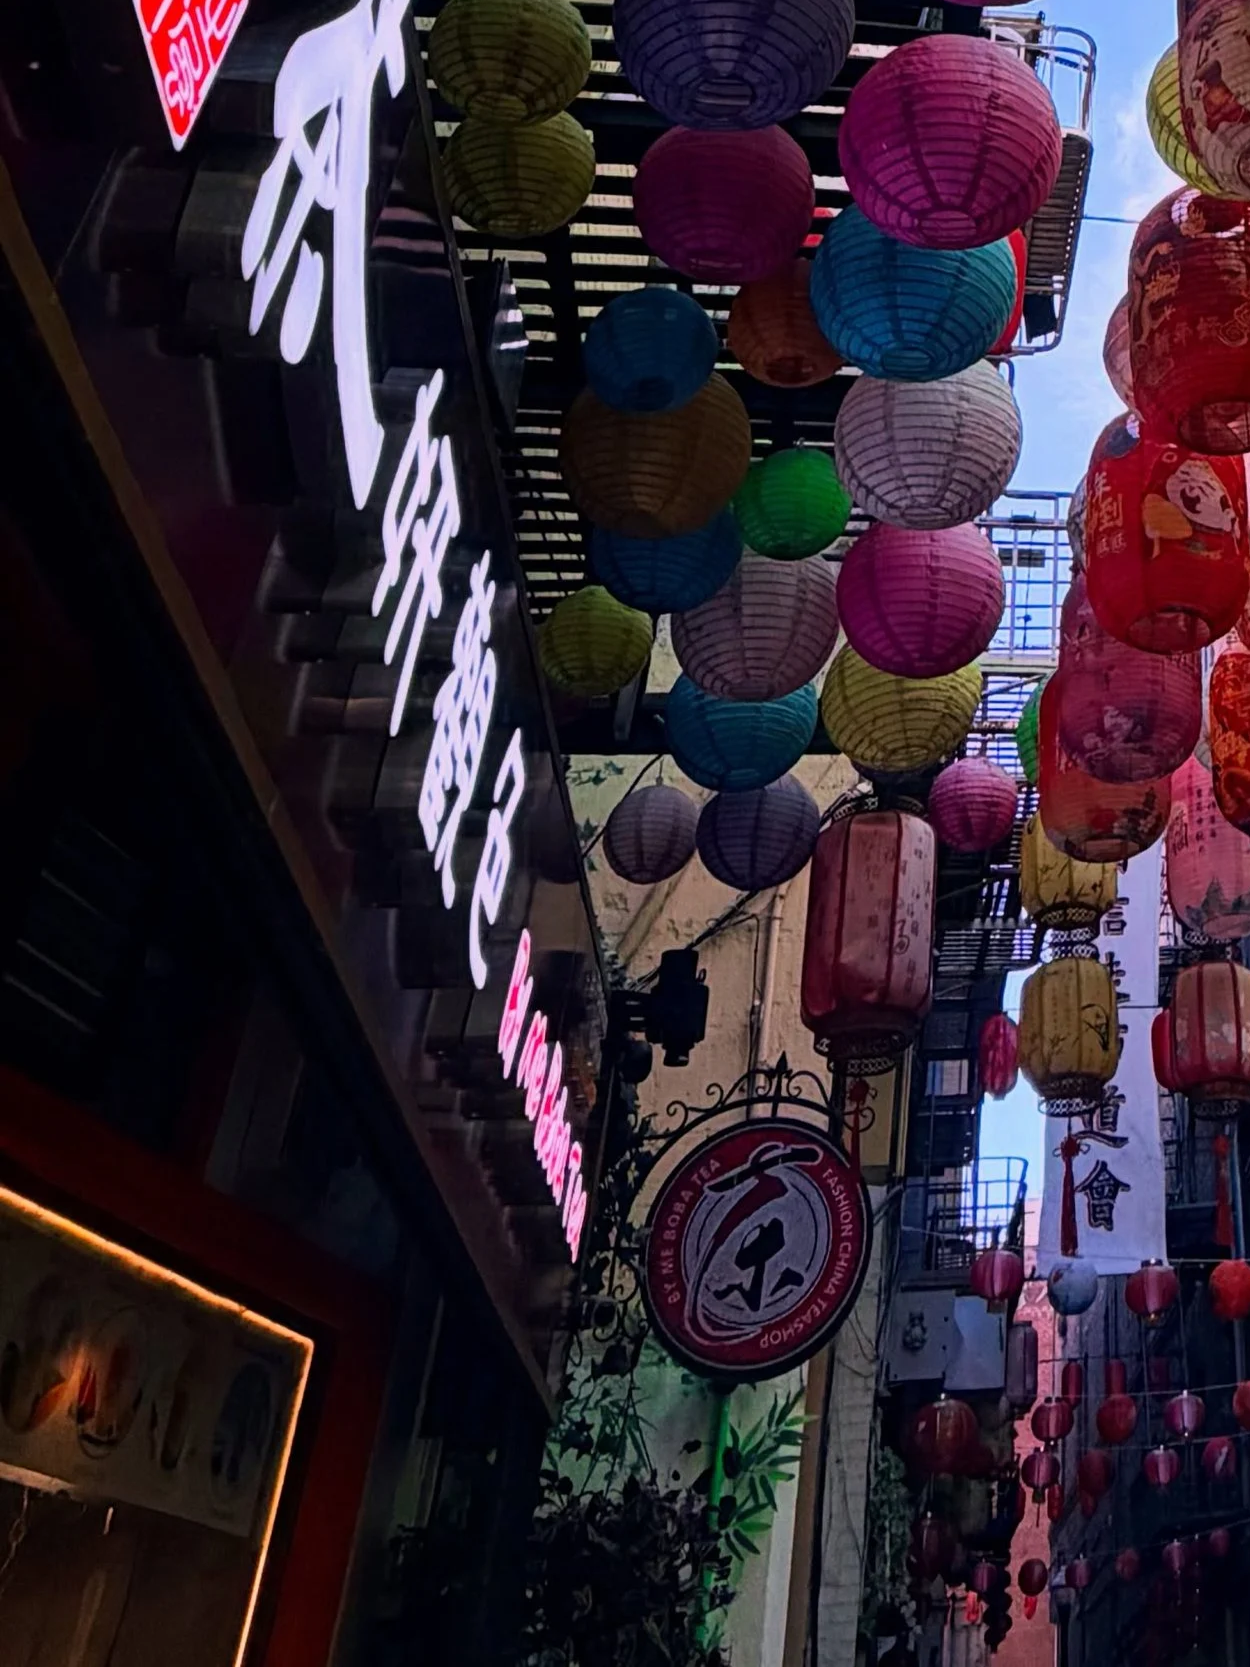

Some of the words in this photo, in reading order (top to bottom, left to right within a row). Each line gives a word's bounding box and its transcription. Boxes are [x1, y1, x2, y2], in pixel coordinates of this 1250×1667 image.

[691, 1157, 722, 1189] TEA
[663, 1189, 695, 1241] BOBA
[821, 1168, 853, 1241] FASHION
[659, 1247, 675, 1272] ME
[825, 1241, 853, 1298] CHINA
[666, 1278, 681, 1305] BY
